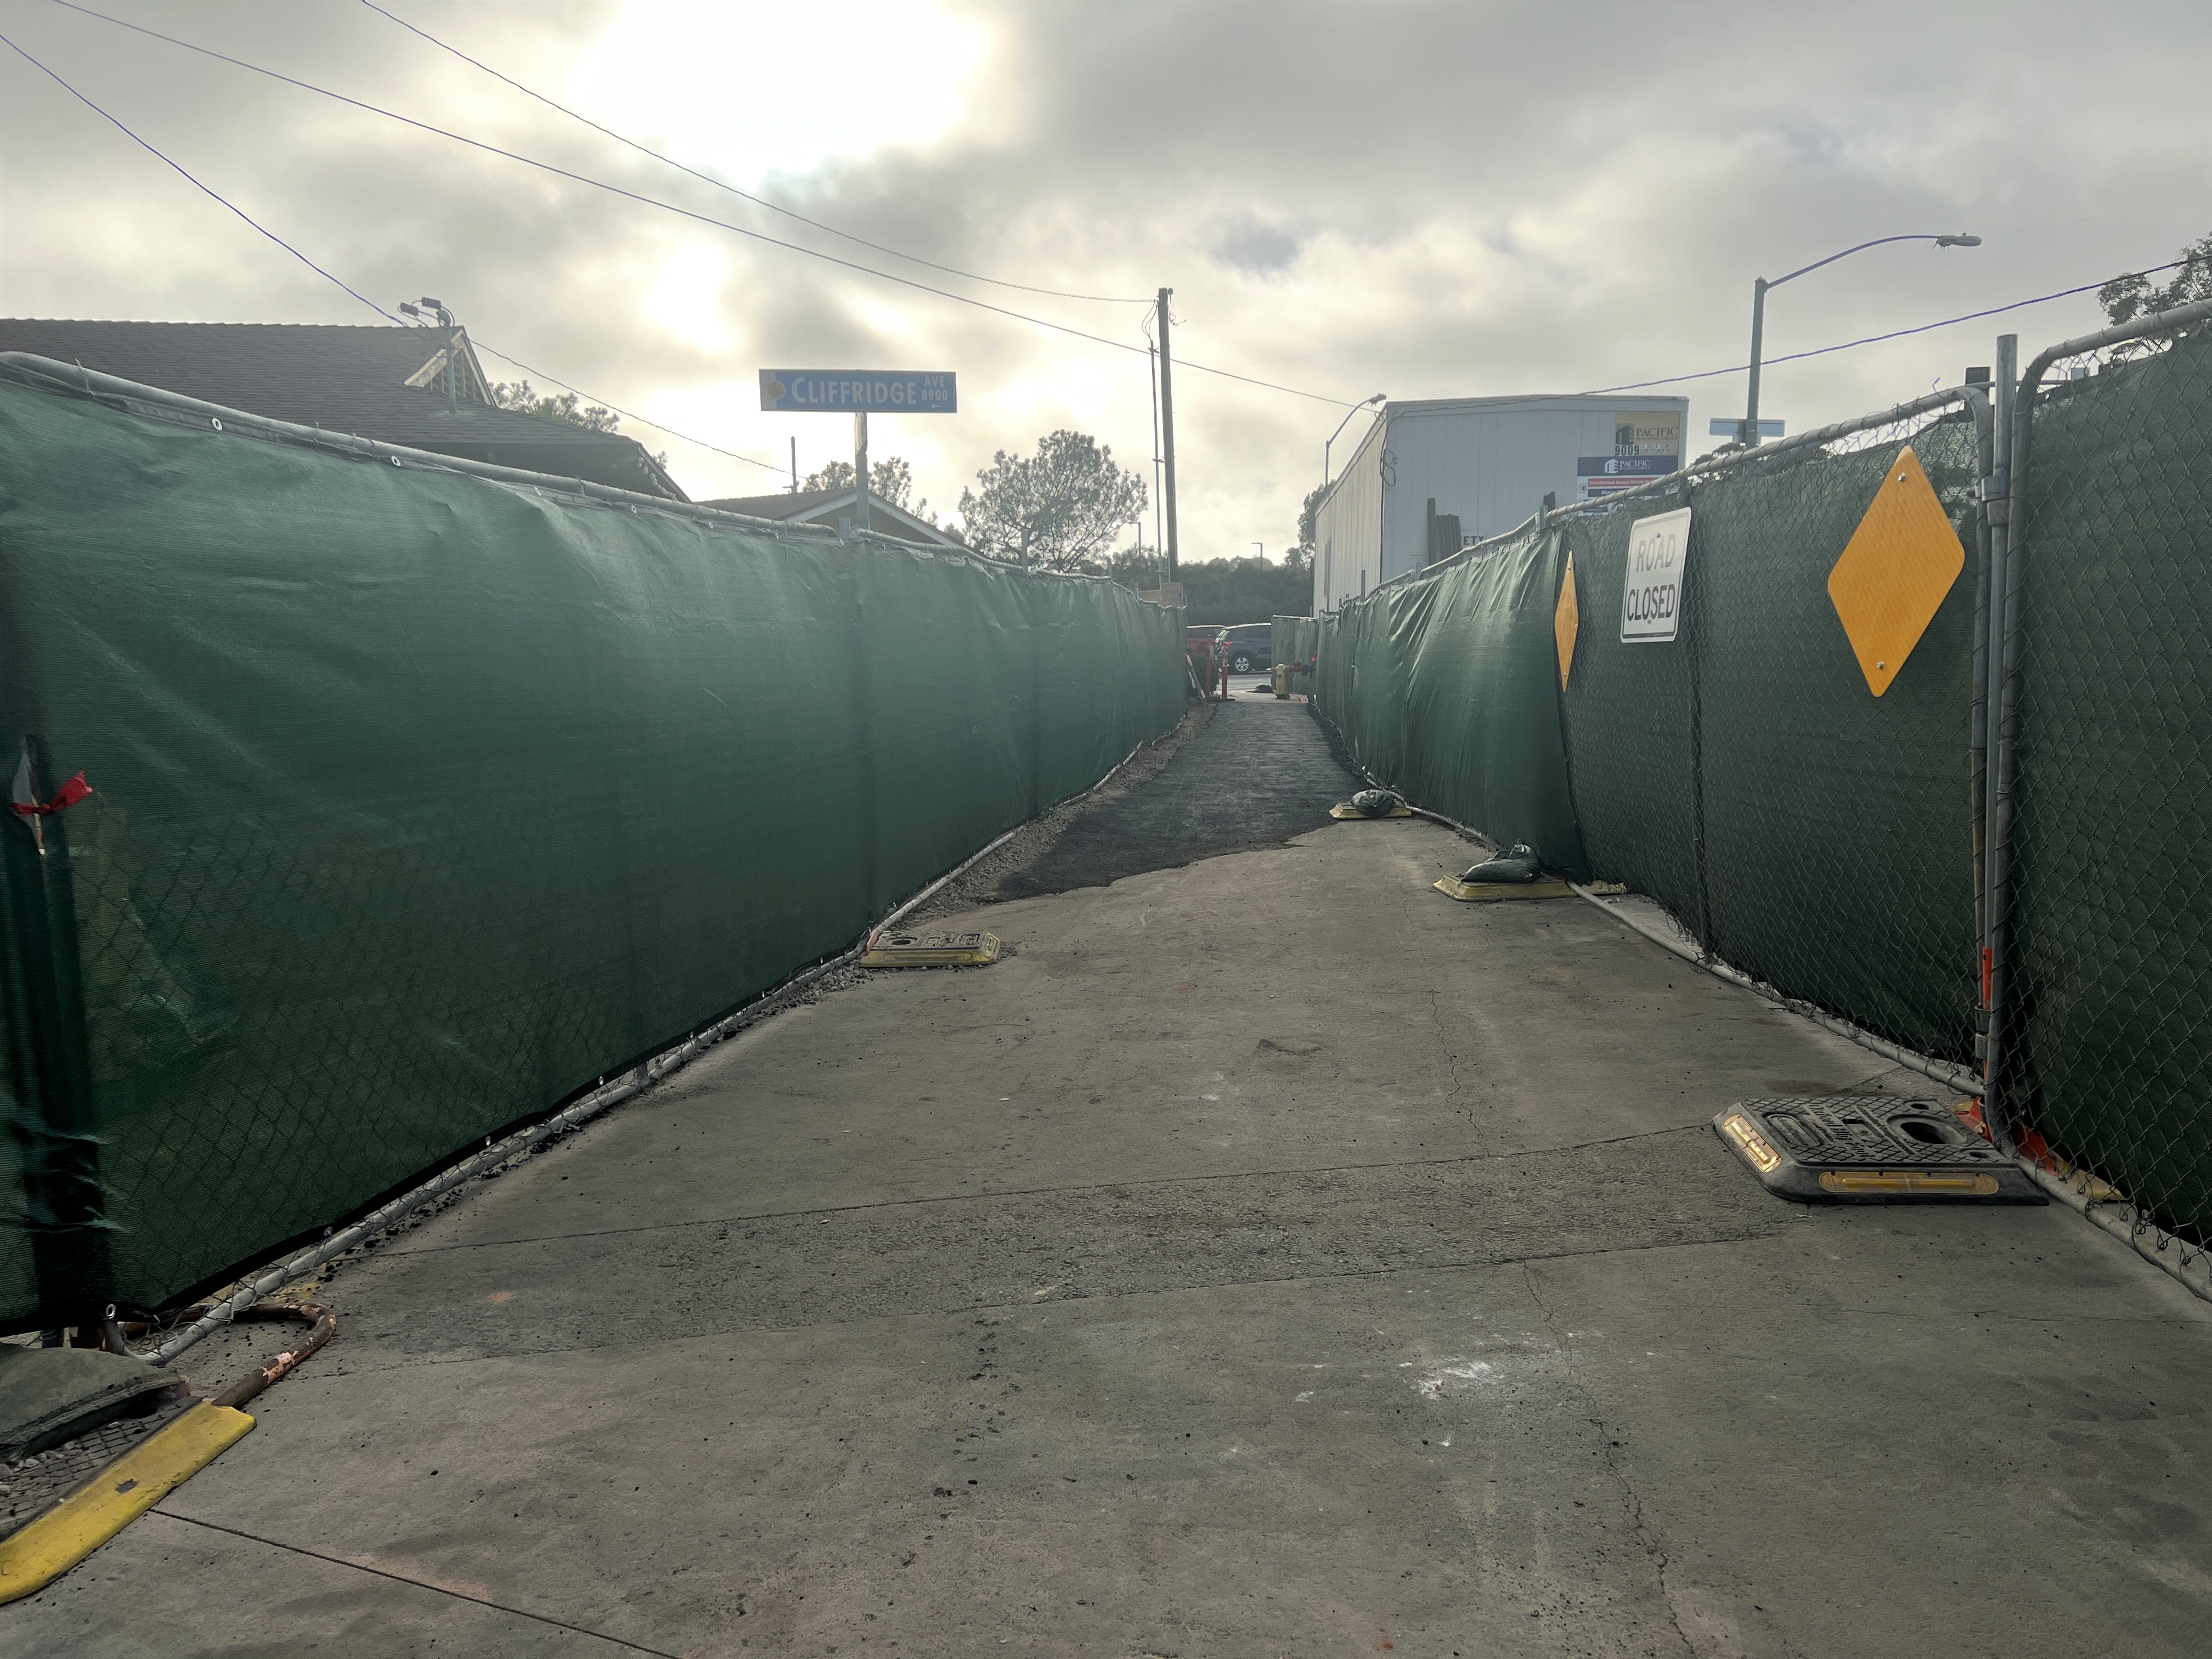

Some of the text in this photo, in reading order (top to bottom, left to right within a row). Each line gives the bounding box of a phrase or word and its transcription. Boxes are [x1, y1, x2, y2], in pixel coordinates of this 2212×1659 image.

[925, 375, 945, 387] AVE
[791, 376, 917, 405] CLIFFRIDGE
[922, 389, 948, 400] 8900
[1635, 427, 1678, 437] PACIFIC
[1615, 445, 1639, 456] 9009
[1463, 535, 1485, 545] ETY
[1636, 534, 1676, 573] ROAD
[1627, 584, 1676, 622] CLOSED
